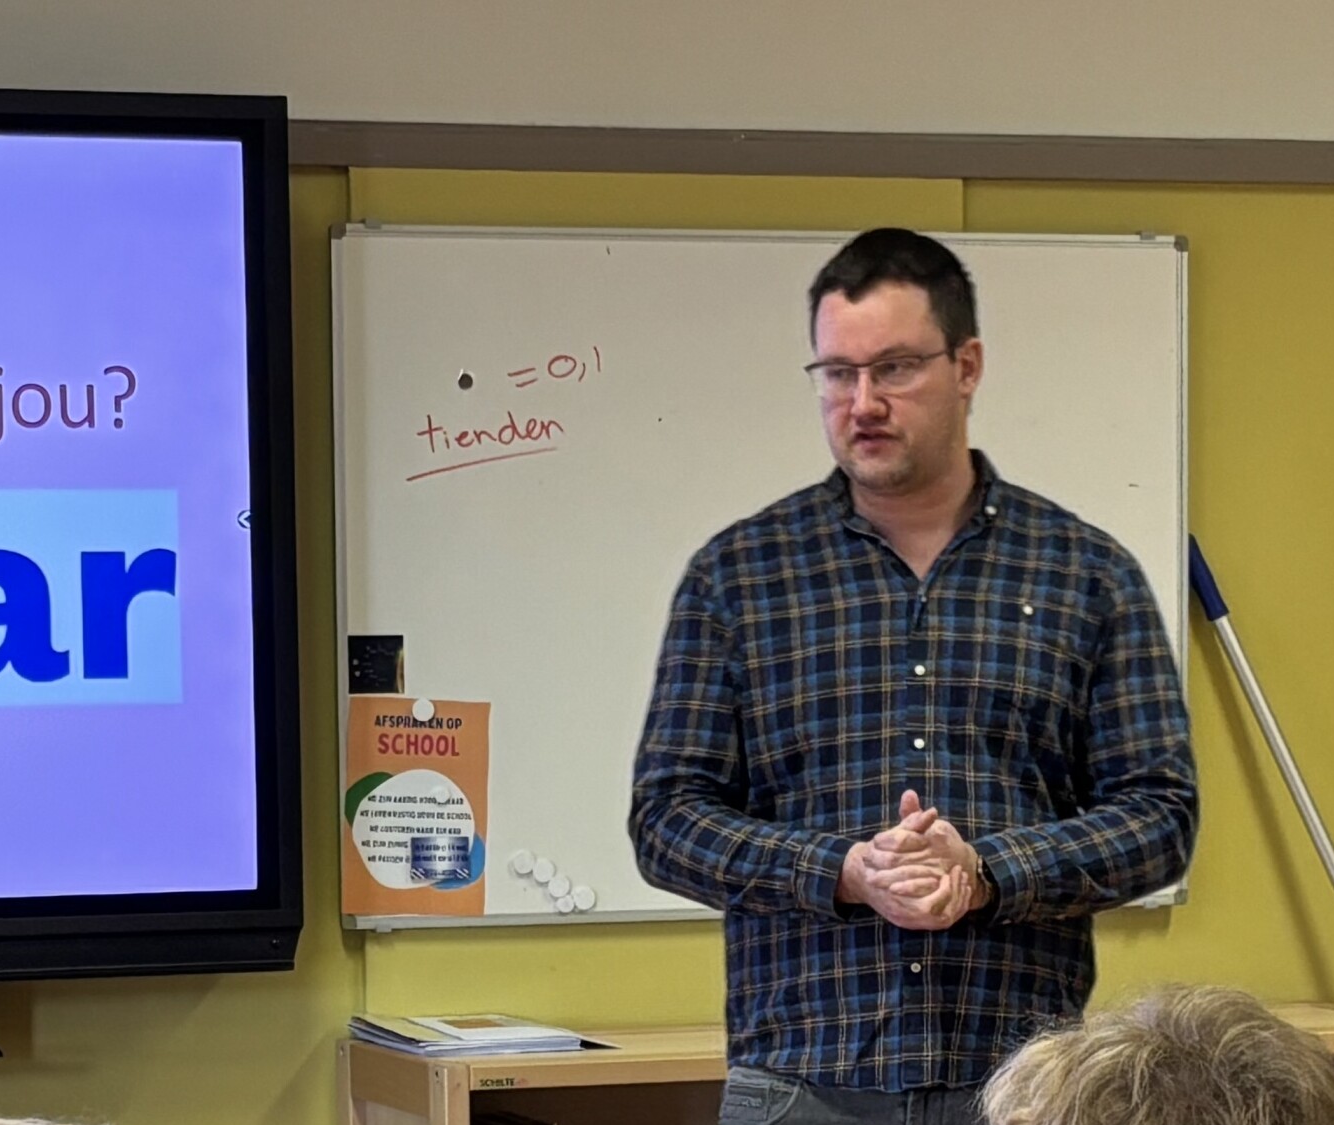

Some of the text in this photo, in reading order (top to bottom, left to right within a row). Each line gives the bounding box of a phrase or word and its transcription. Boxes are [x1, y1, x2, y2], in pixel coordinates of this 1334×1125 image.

[417, 411, 564, 453] tienden
[446, 718, 462, 729] OP
[377, 733, 460, 756] SCHOOL
